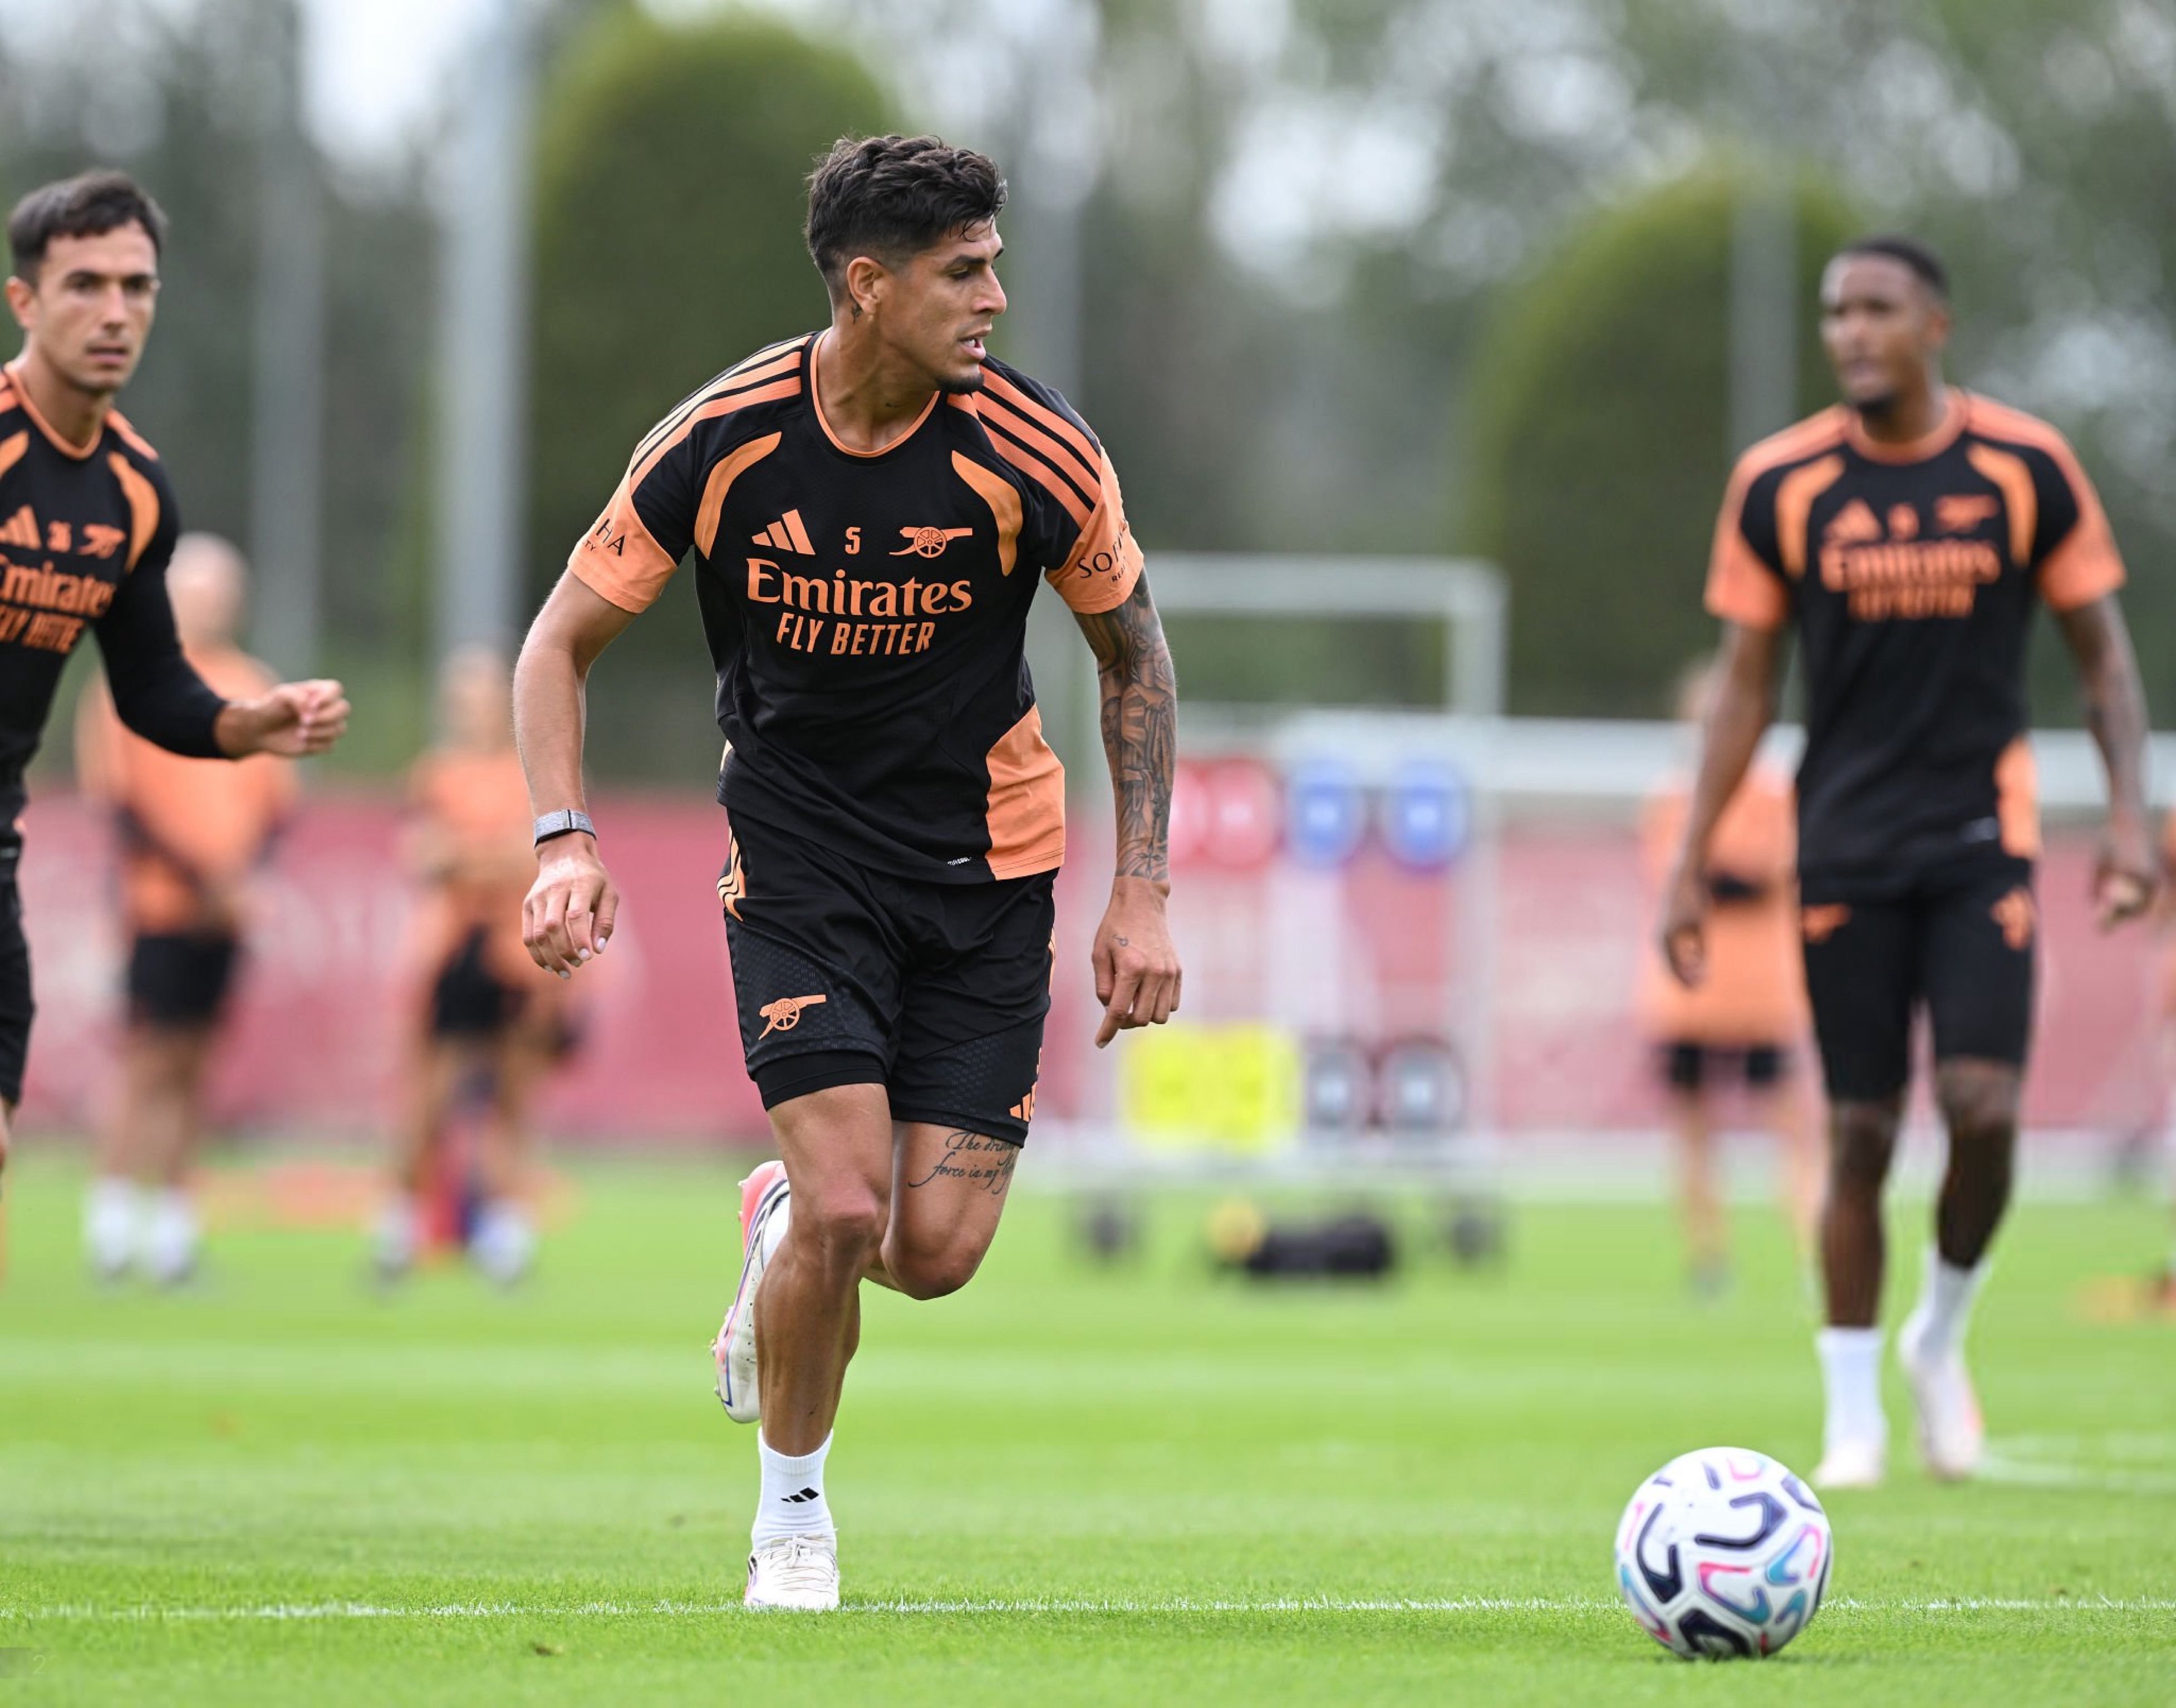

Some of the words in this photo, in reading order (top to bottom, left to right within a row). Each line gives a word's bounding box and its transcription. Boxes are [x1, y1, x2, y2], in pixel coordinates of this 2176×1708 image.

[746, 558, 972, 617] Emirates
[777, 612, 824, 653] FLY
[831, 622, 935, 655] BETTER
